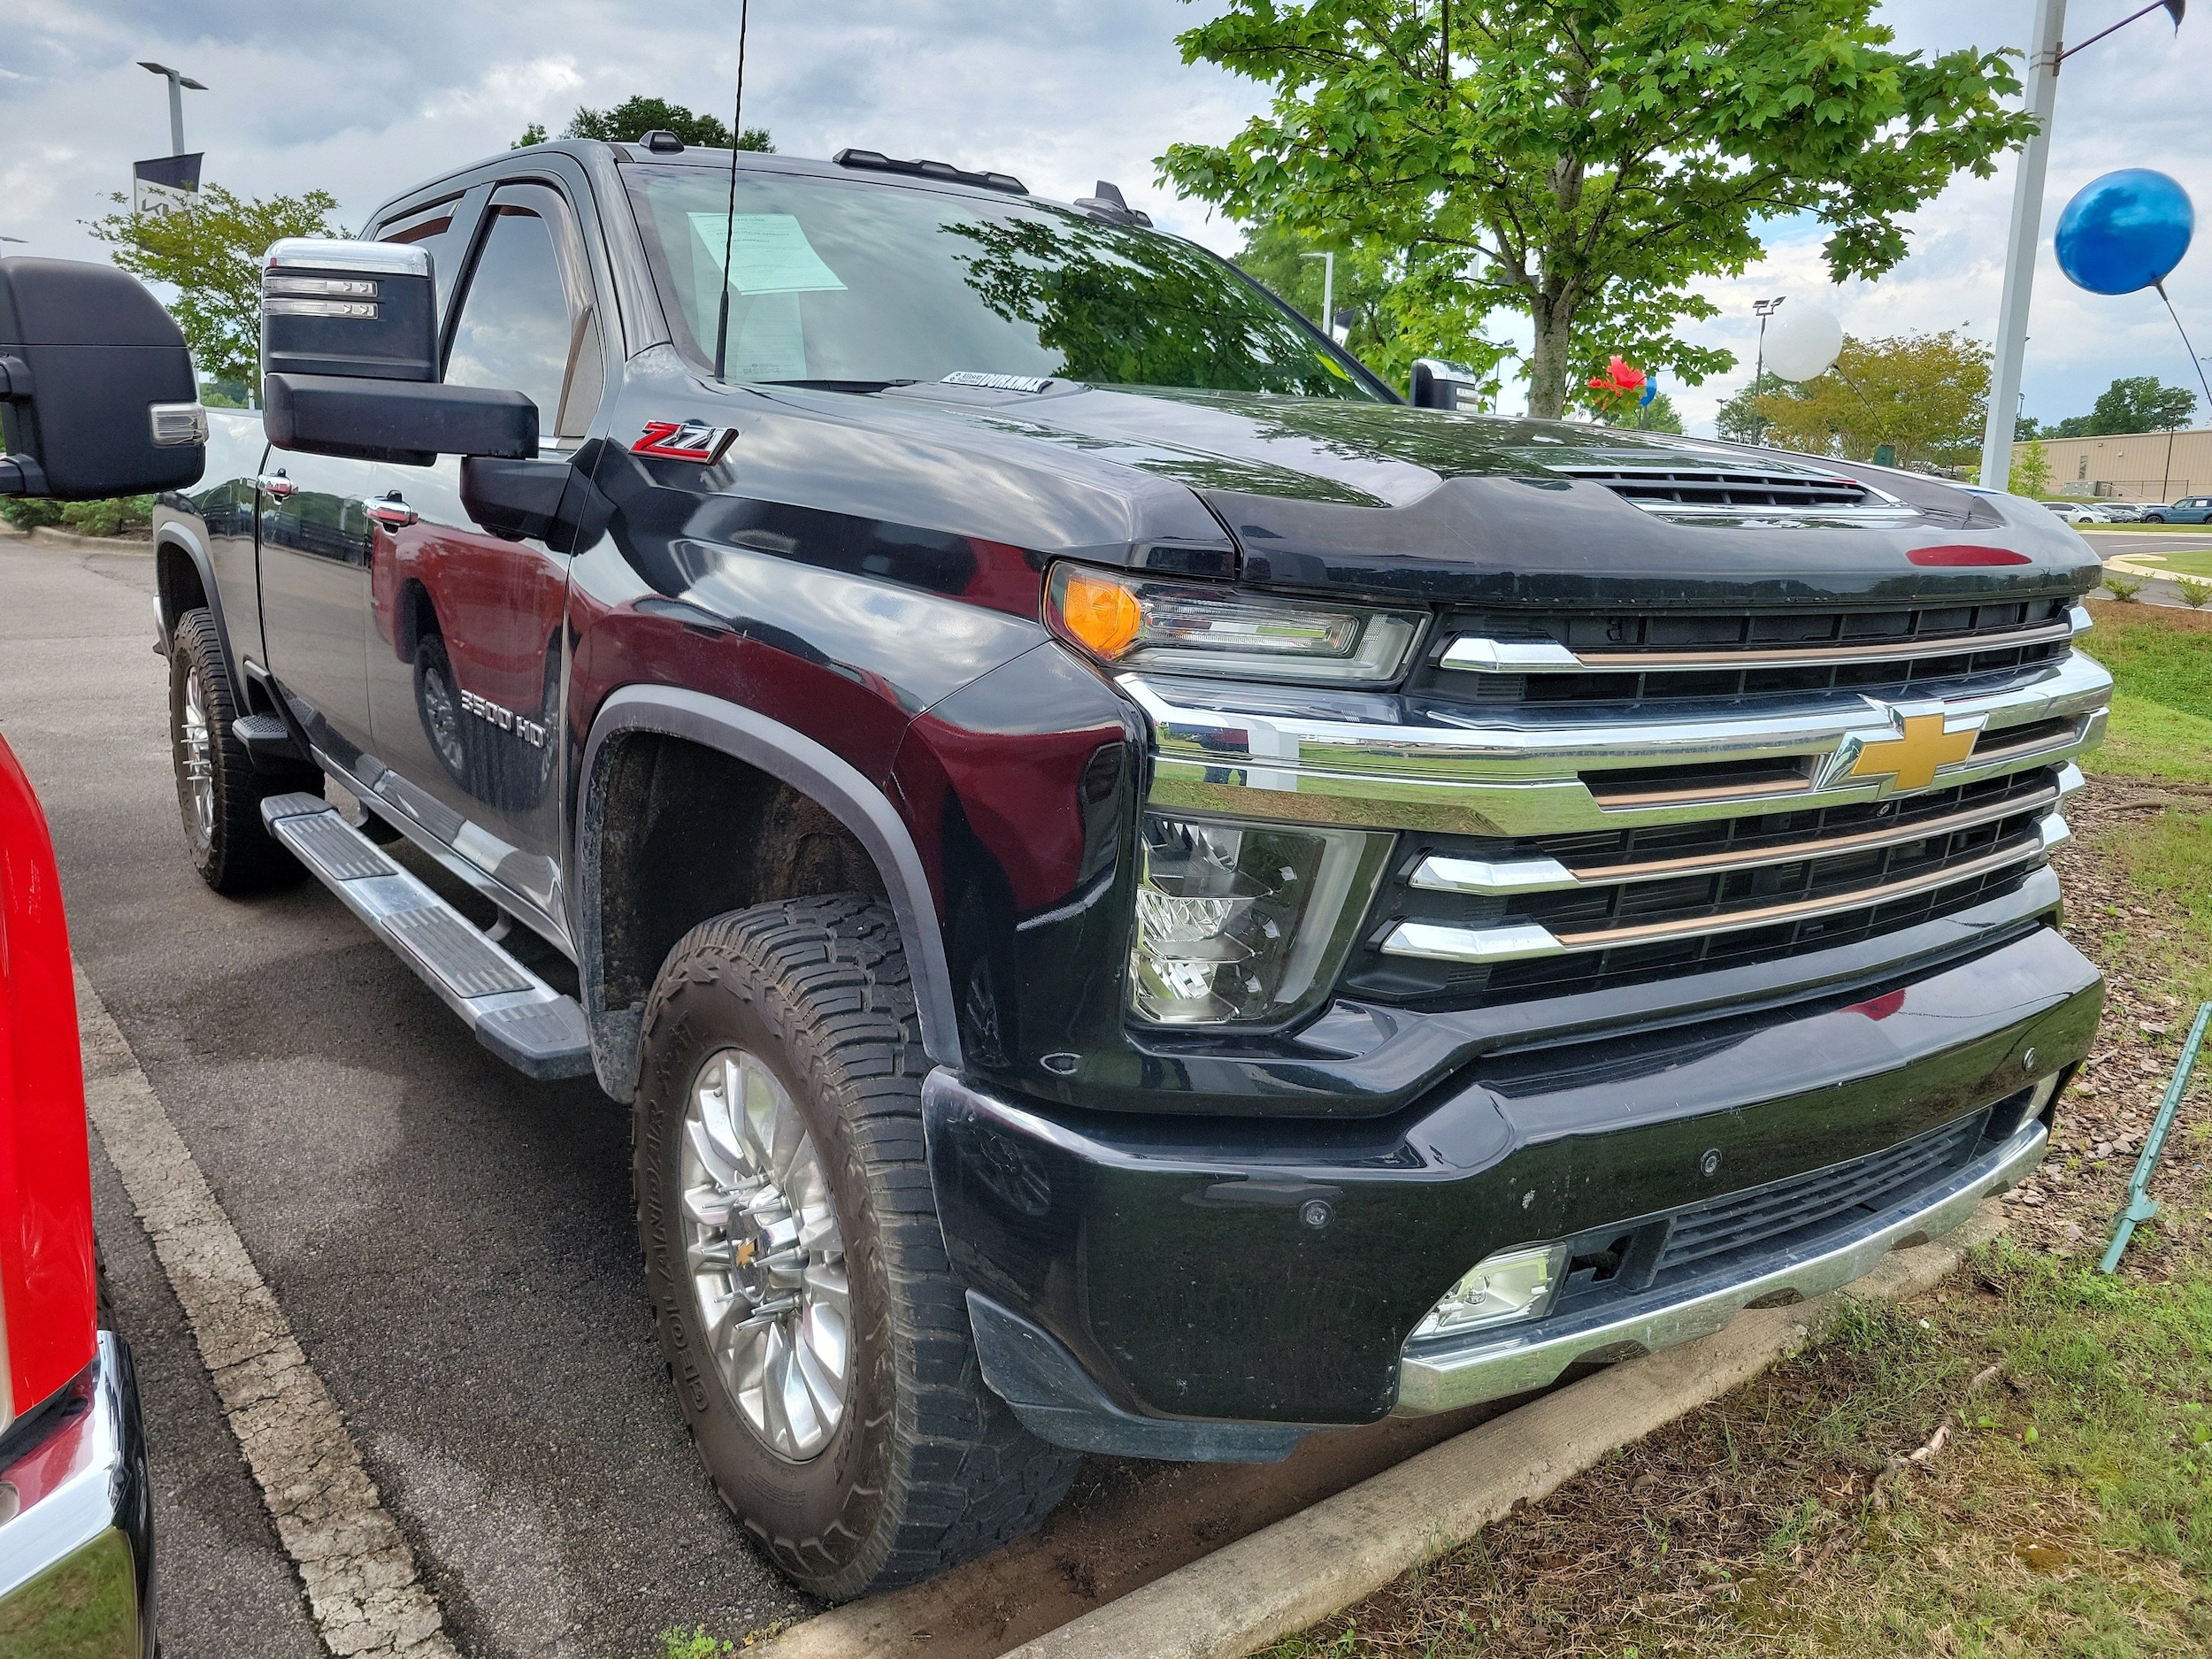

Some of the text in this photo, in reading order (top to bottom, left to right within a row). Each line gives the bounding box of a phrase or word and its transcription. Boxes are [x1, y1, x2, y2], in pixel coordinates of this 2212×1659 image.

[979, 373, 1044, 392] DURAMAX
[627, 419, 738, 466] Z71
[461, 689, 546, 749] 3500 HD
